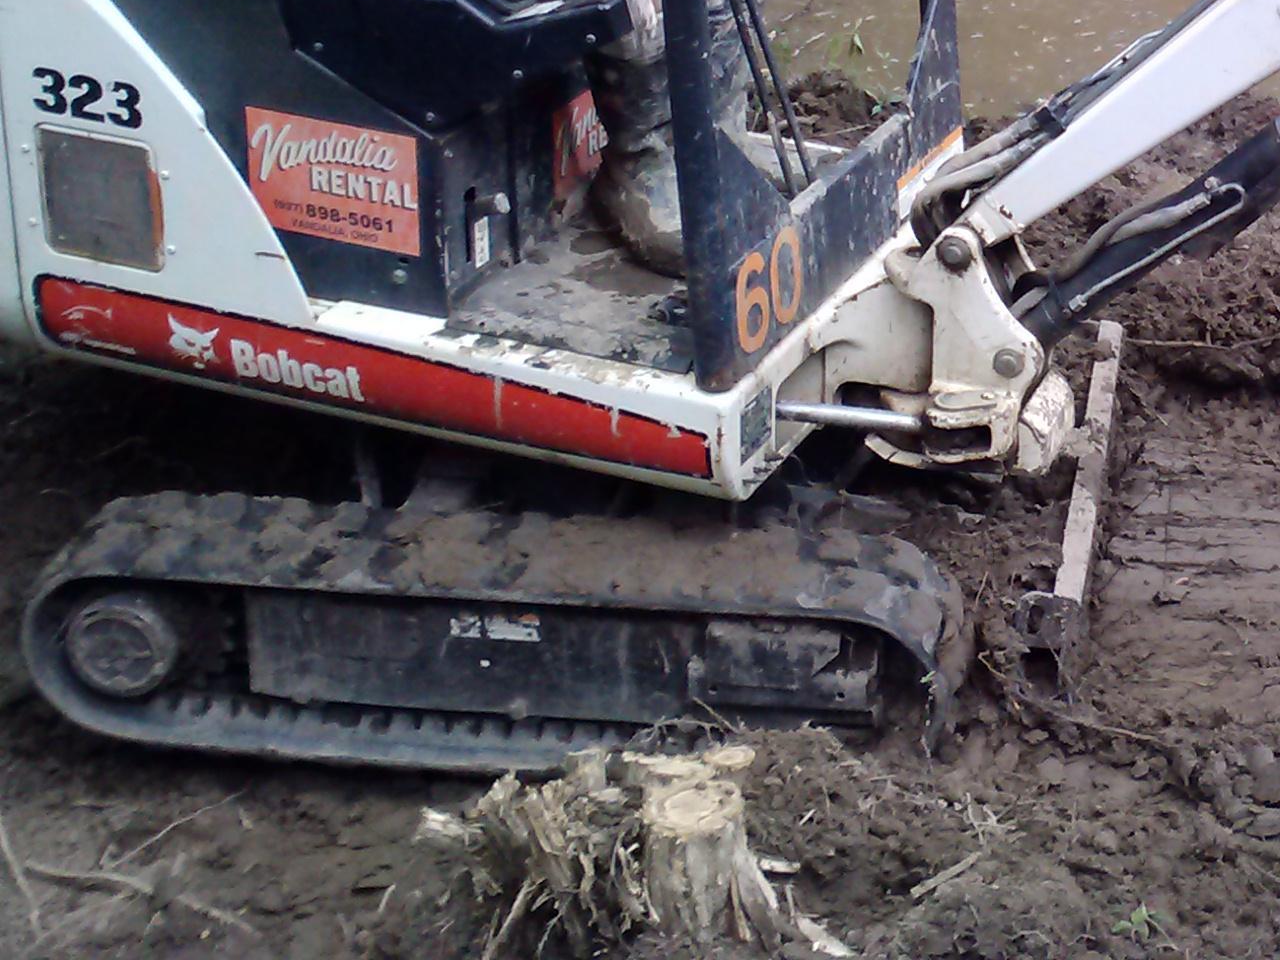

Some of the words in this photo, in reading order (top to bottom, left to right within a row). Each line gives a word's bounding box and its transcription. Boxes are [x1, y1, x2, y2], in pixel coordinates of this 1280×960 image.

[32, 67, 142, 129] 323
[250, 123, 398, 182] Vandalia
[305, 203, 394, 233] 898-5061
[311, 165, 418, 211] RENTAL
[736, 226, 801, 354] 60
[230, 339, 365, 402] Bobcat
